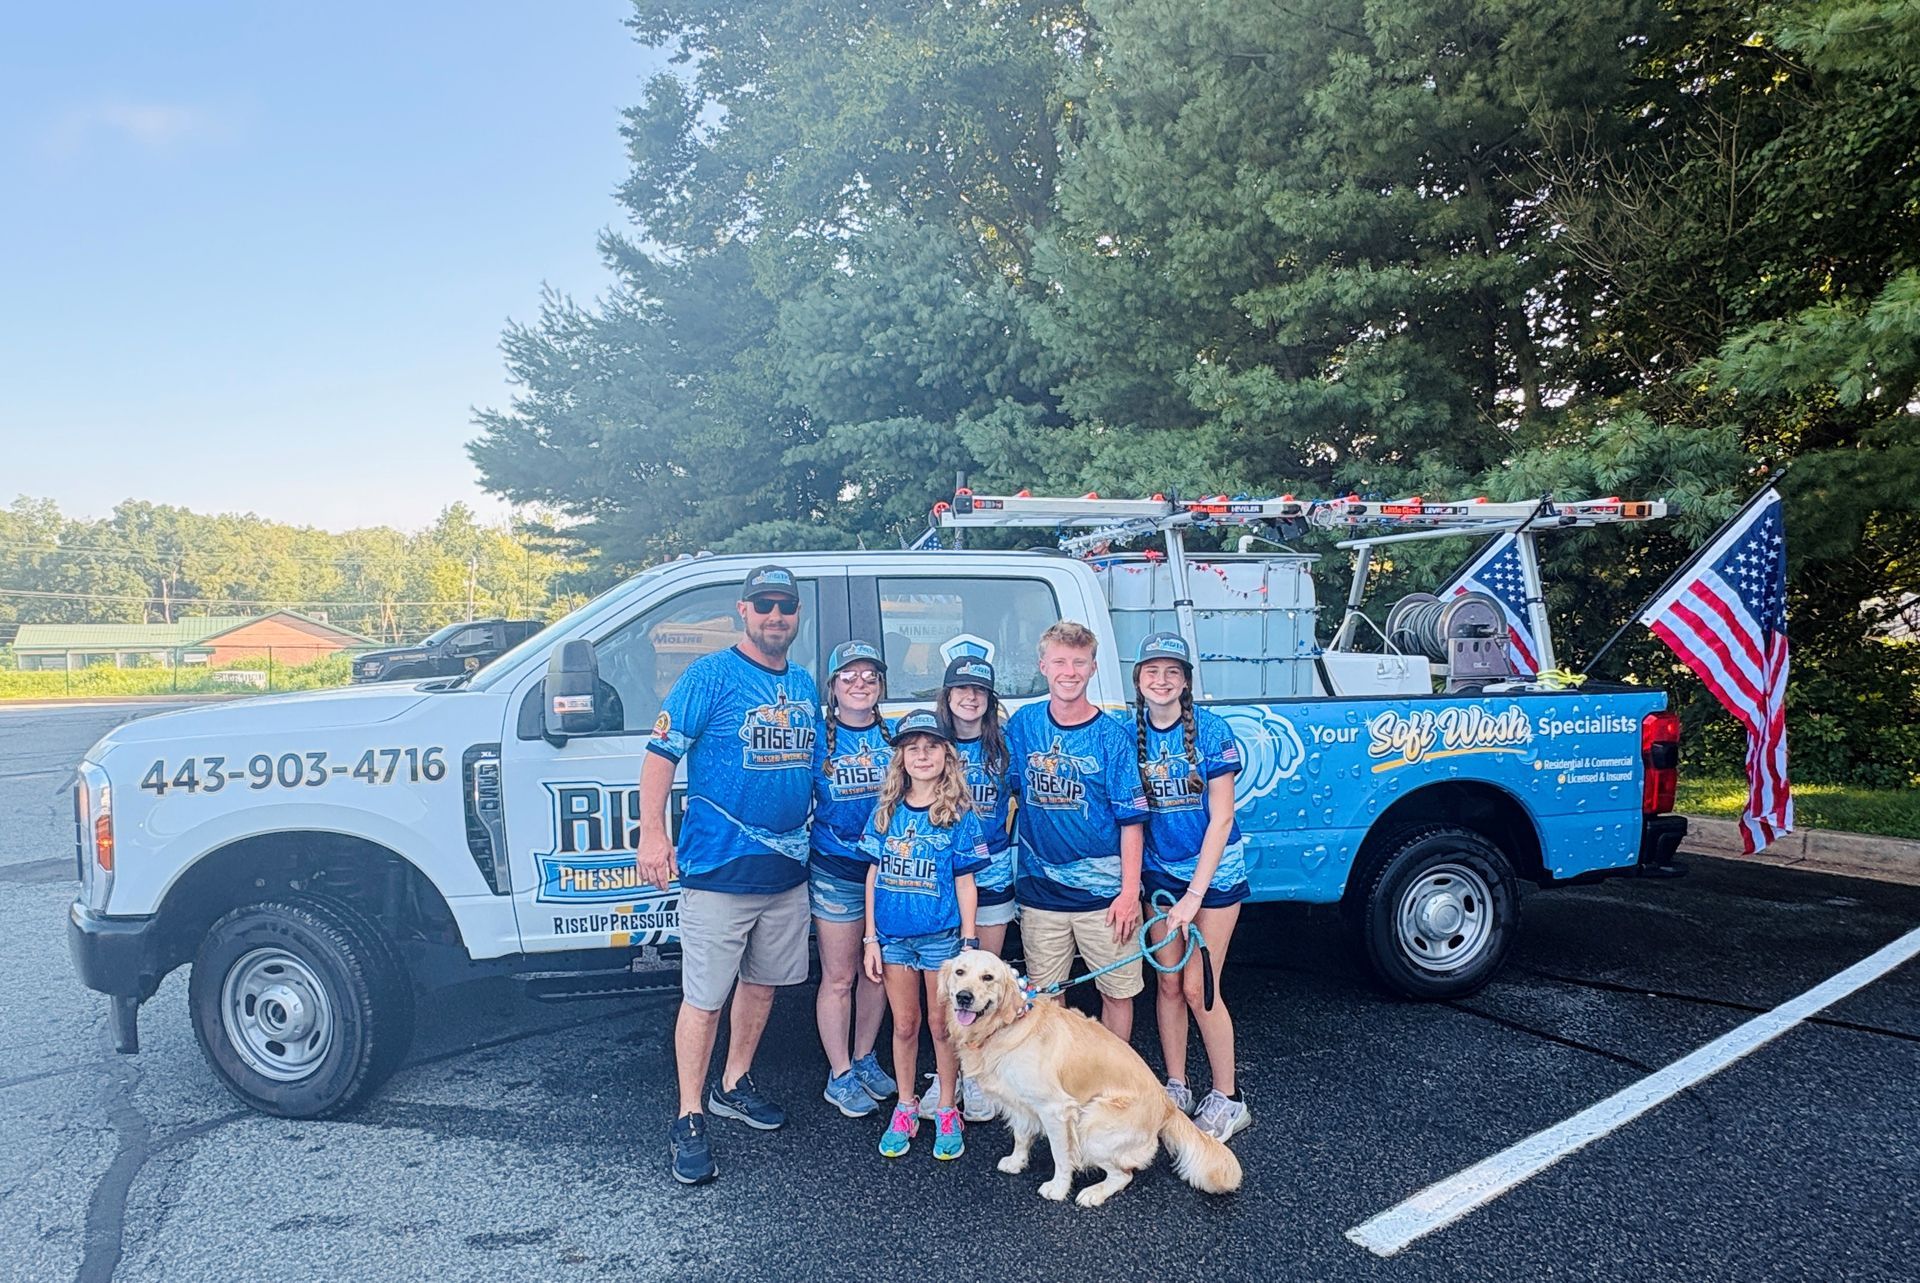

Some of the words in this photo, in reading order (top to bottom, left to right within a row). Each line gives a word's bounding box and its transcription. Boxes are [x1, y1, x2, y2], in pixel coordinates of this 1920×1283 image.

[753, 727, 792, 749] RISE
[796, 728, 816, 749] UP
[1309, 725, 1359, 743] Your
[1369, 711, 1436, 764] Soft
[1436, 706, 1531, 749] Wash
[1538, 715, 1637, 739] Specialists
[140, 746, 446, 795] 443-903-4716
[1544, 758, 1583, 769] Residential
[1584, 757, 1591, 768] &
[1591, 755, 1633, 767] Commercial
[835, 767, 880, 785] RISE
[1567, 771, 1598, 783] Licensed
[1599, 770, 1605, 782] &
[1606, 770, 1633, 782] Insured
[973, 785, 994, 801] UP
